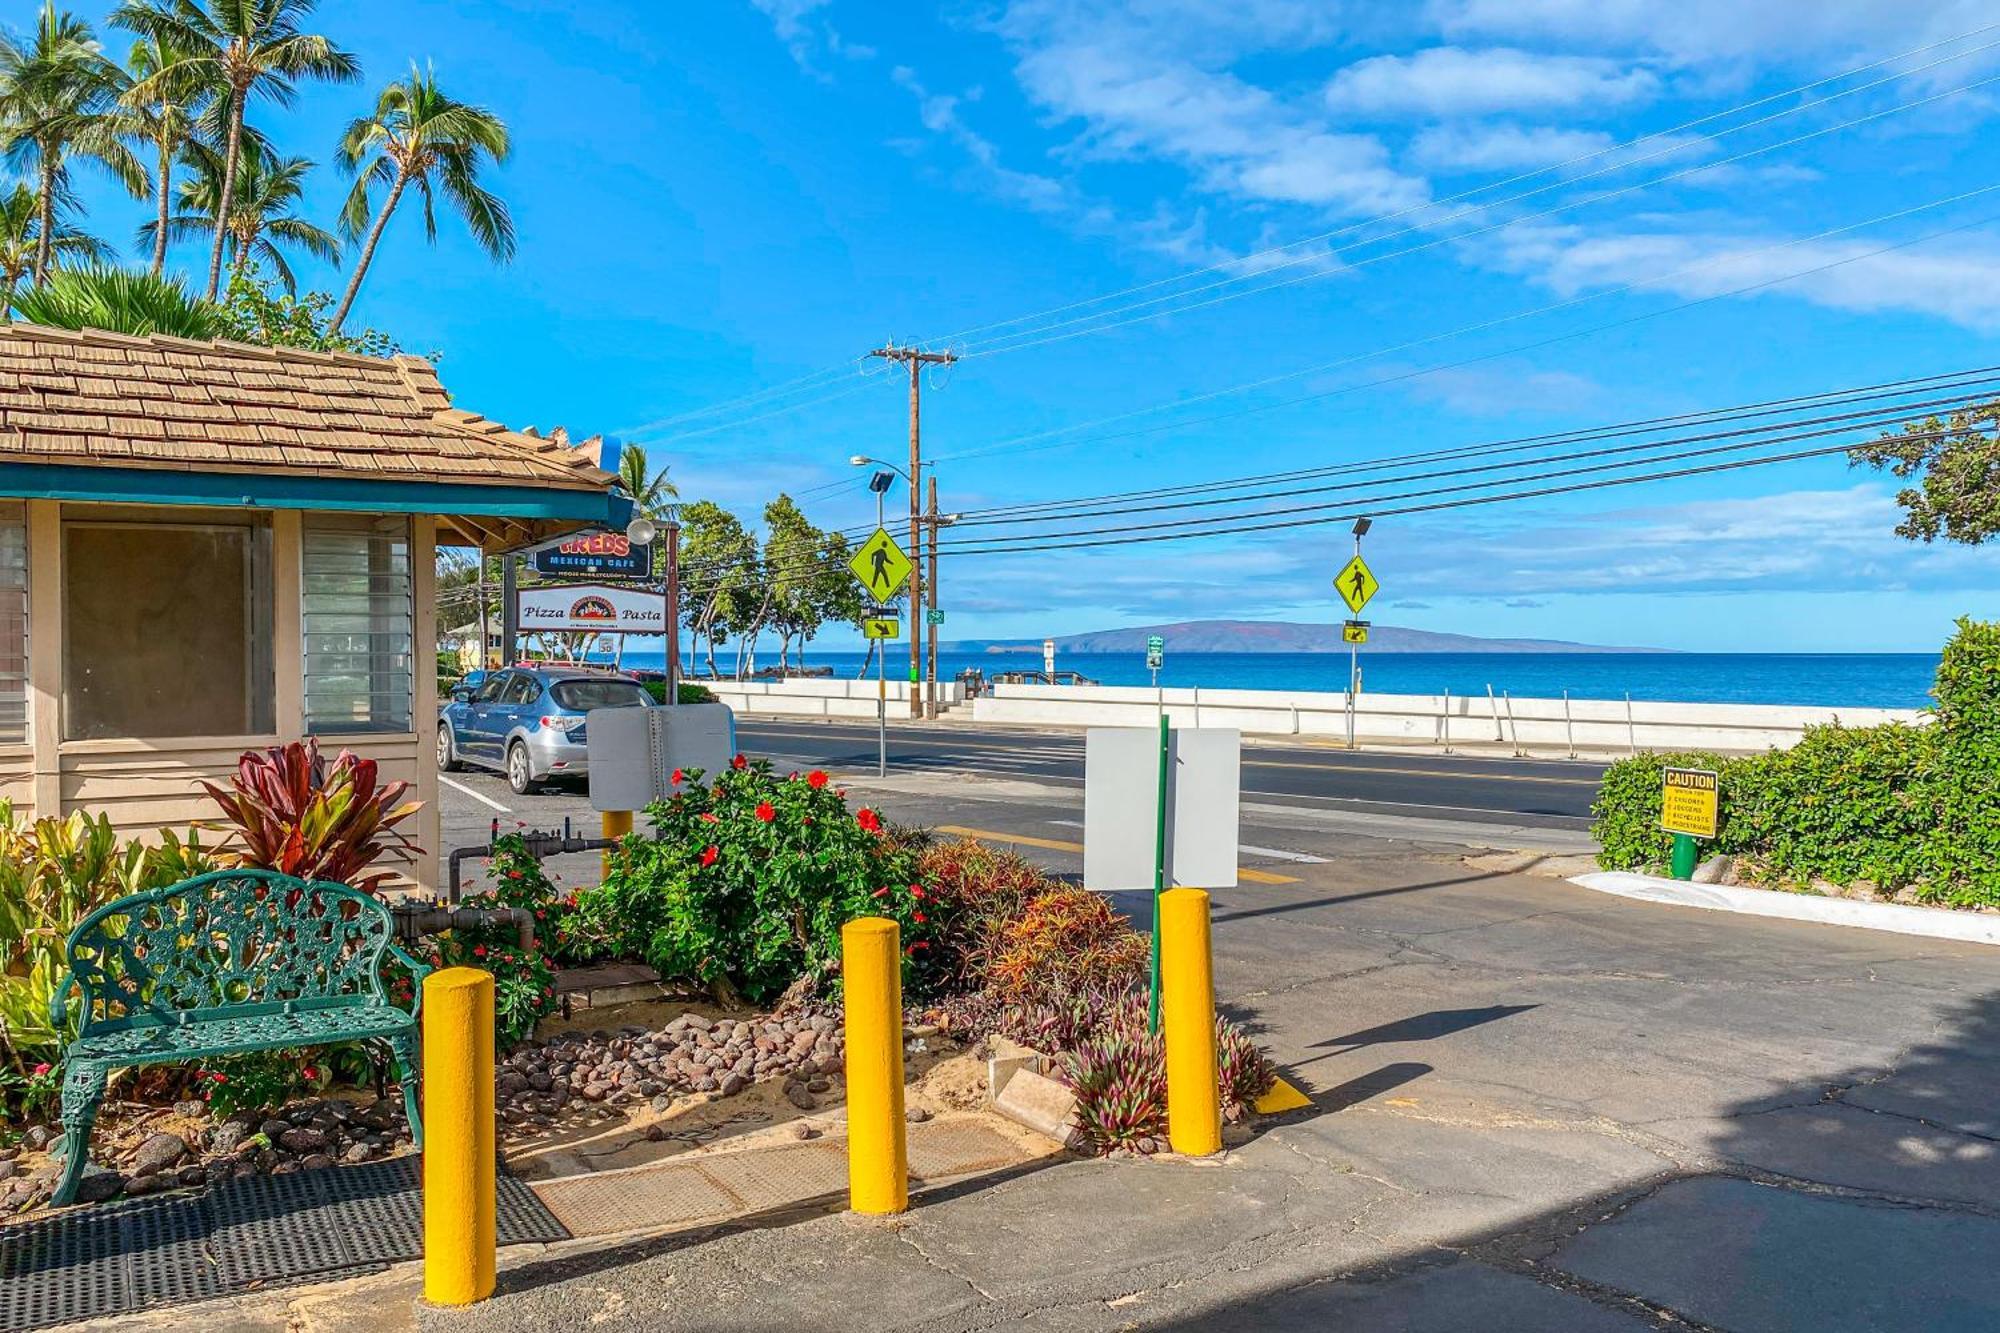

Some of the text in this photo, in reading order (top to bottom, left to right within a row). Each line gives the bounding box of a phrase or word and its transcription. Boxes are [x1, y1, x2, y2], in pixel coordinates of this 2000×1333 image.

[550, 557, 635, 568] MEXICAN CAFE
[524, 607, 565, 618] Pizza
[622, 609, 662, 621] Pasta
[1667, 772, 1714, 789] CAUTION
